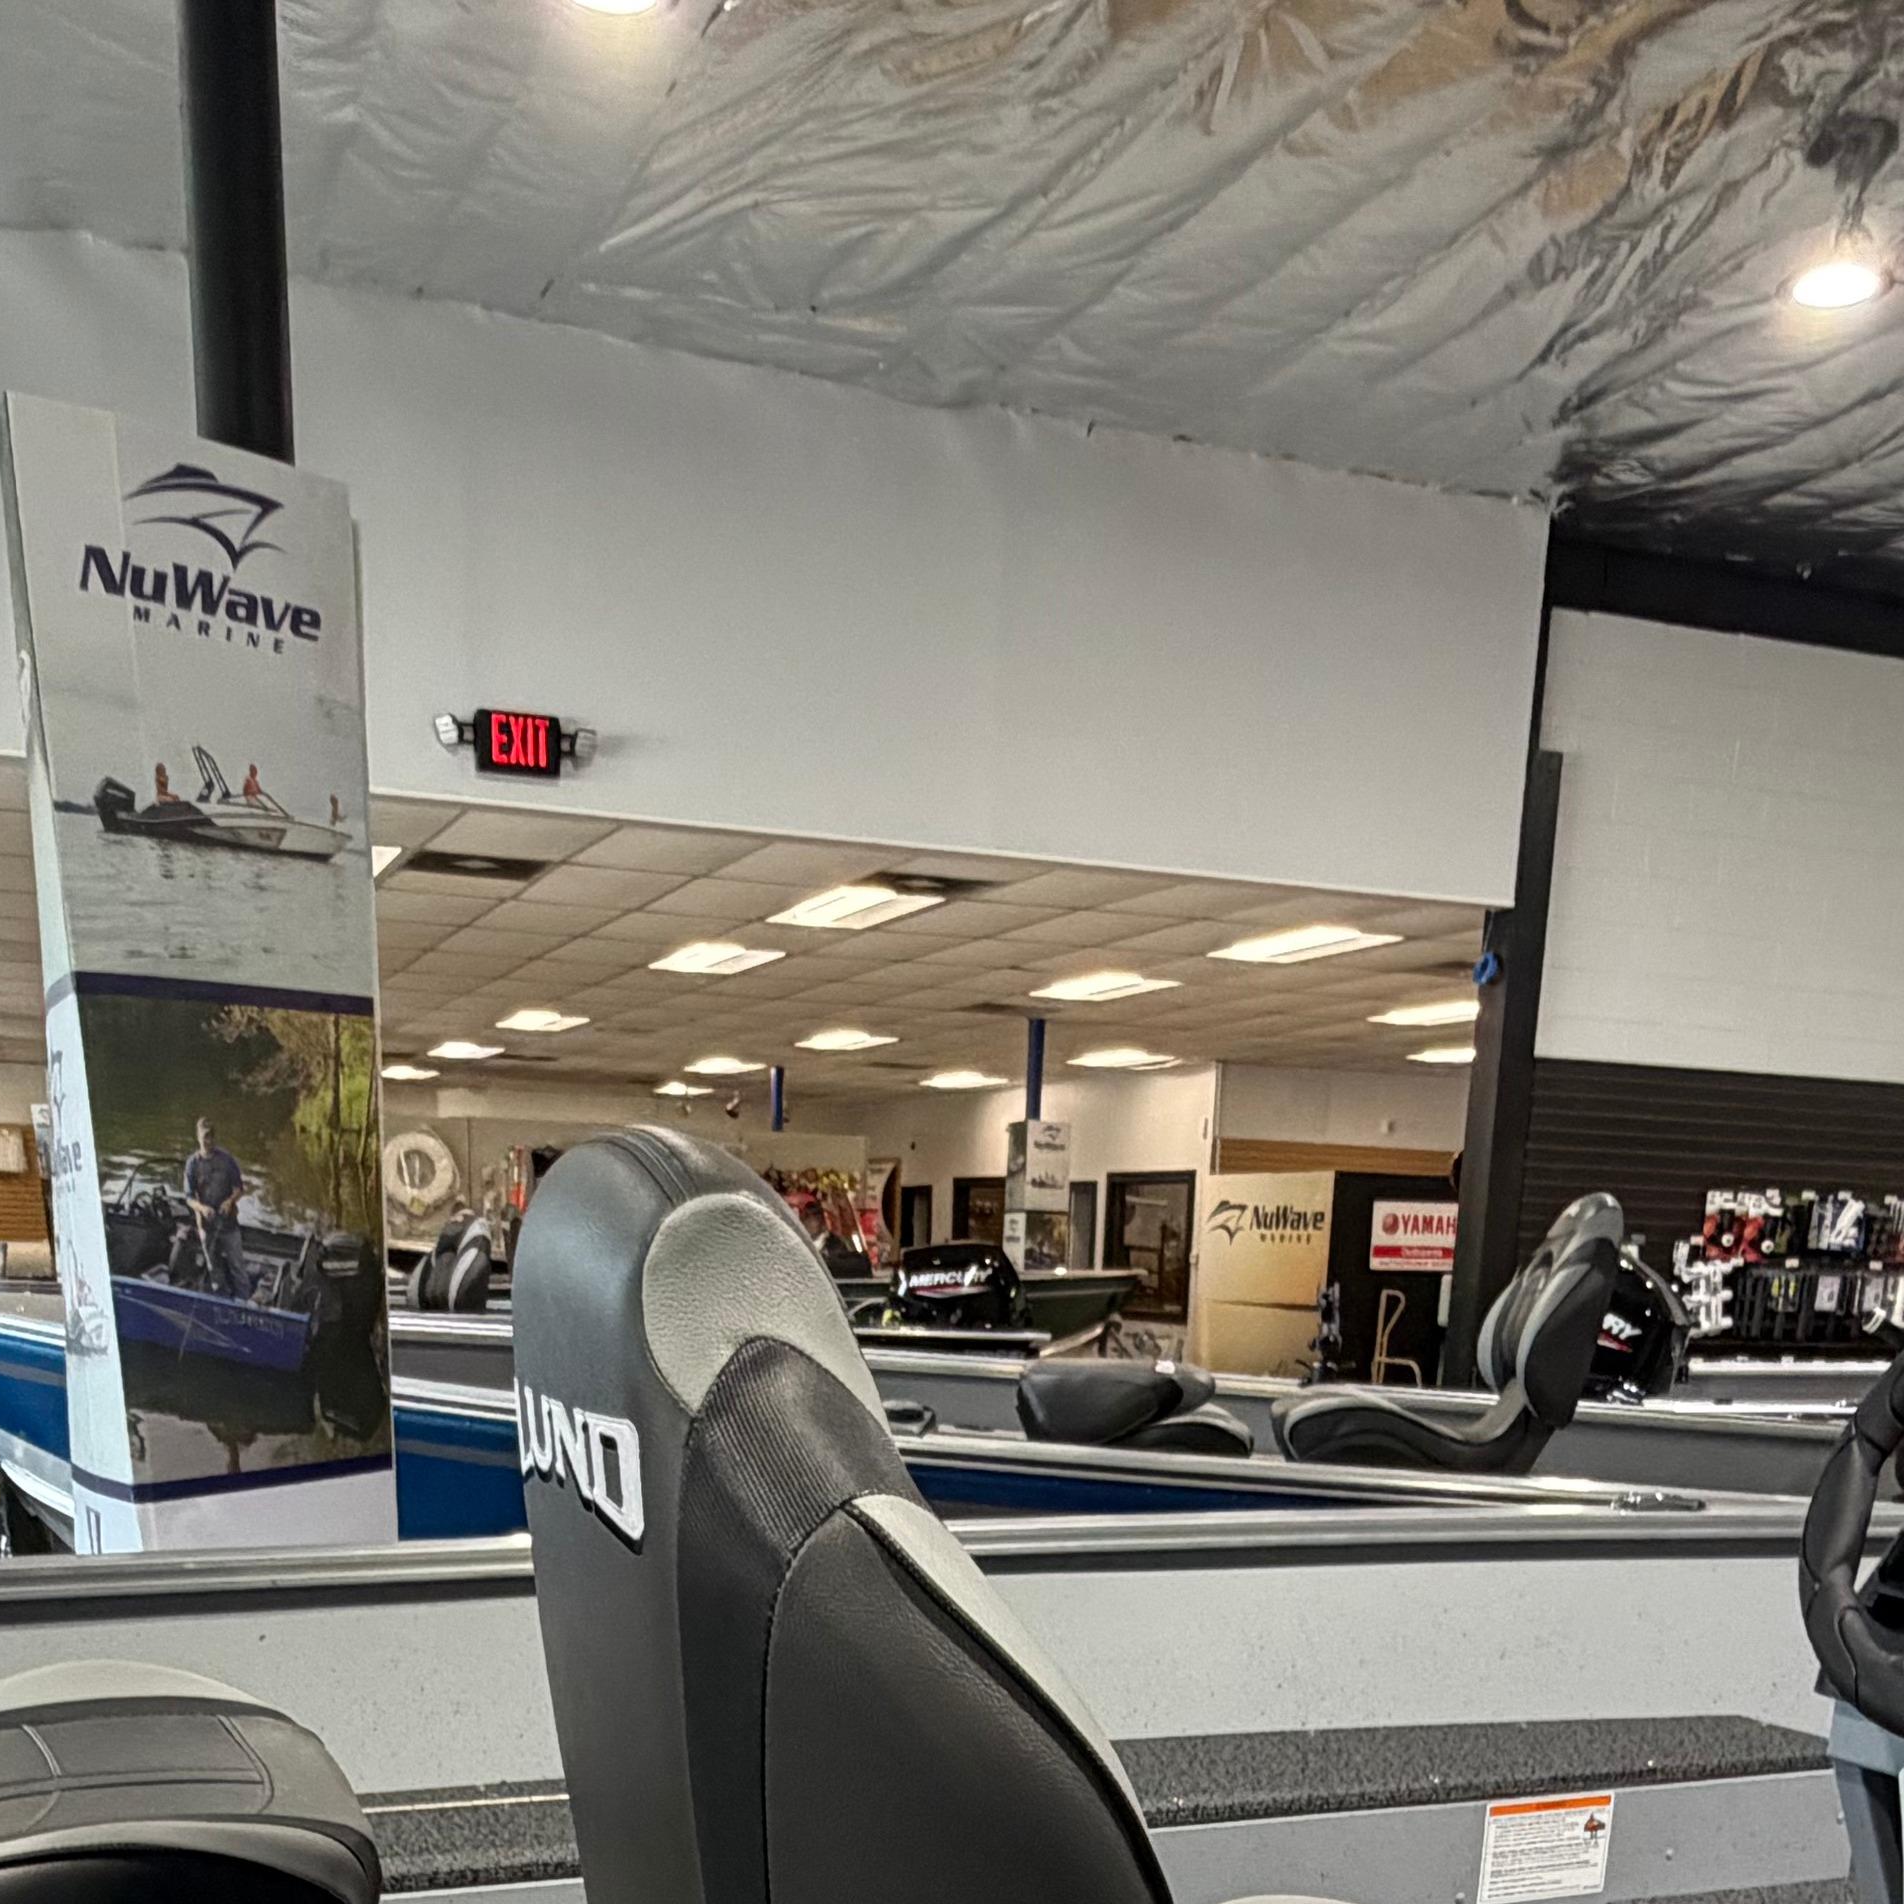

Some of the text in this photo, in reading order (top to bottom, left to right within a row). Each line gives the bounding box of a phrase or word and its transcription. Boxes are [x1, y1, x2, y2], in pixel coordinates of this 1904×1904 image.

[79, 544, 322, 643] NuWave
[132, 605, 286, 655] MARINE
[490, 712, 550, 769] EXIT
[1250, 1205, 1326, 1231] NuWave
[1401, 1213, 1457, 1236] YAMAH
[514, 1376, 645, 1553] LUND
